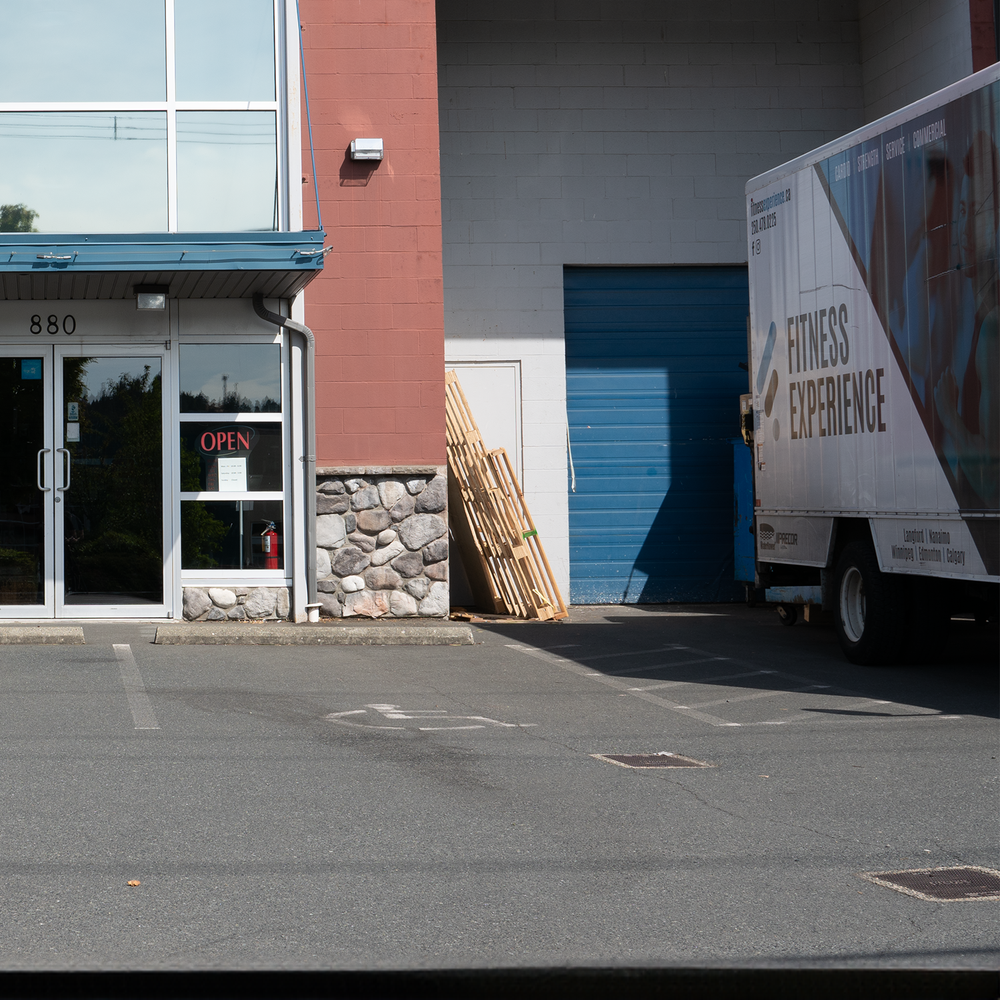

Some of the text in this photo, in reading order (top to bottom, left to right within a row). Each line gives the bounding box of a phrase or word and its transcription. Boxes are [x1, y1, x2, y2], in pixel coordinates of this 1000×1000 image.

[835, 118, 947, 181] CARDIO STRENGTH SERVICE COMMERCIAL
[30, 314, 76, 335] 880
[787, 303, 850, 374] FITNESS
[789, 368, 887, 440] EXPERIENCE
[200, 431, 250, 452] OPEN
[903, 528, 951, 544] Langford Nanaimo
[891, 545, 966, 566] Winnipeg Edmonton Calgary
